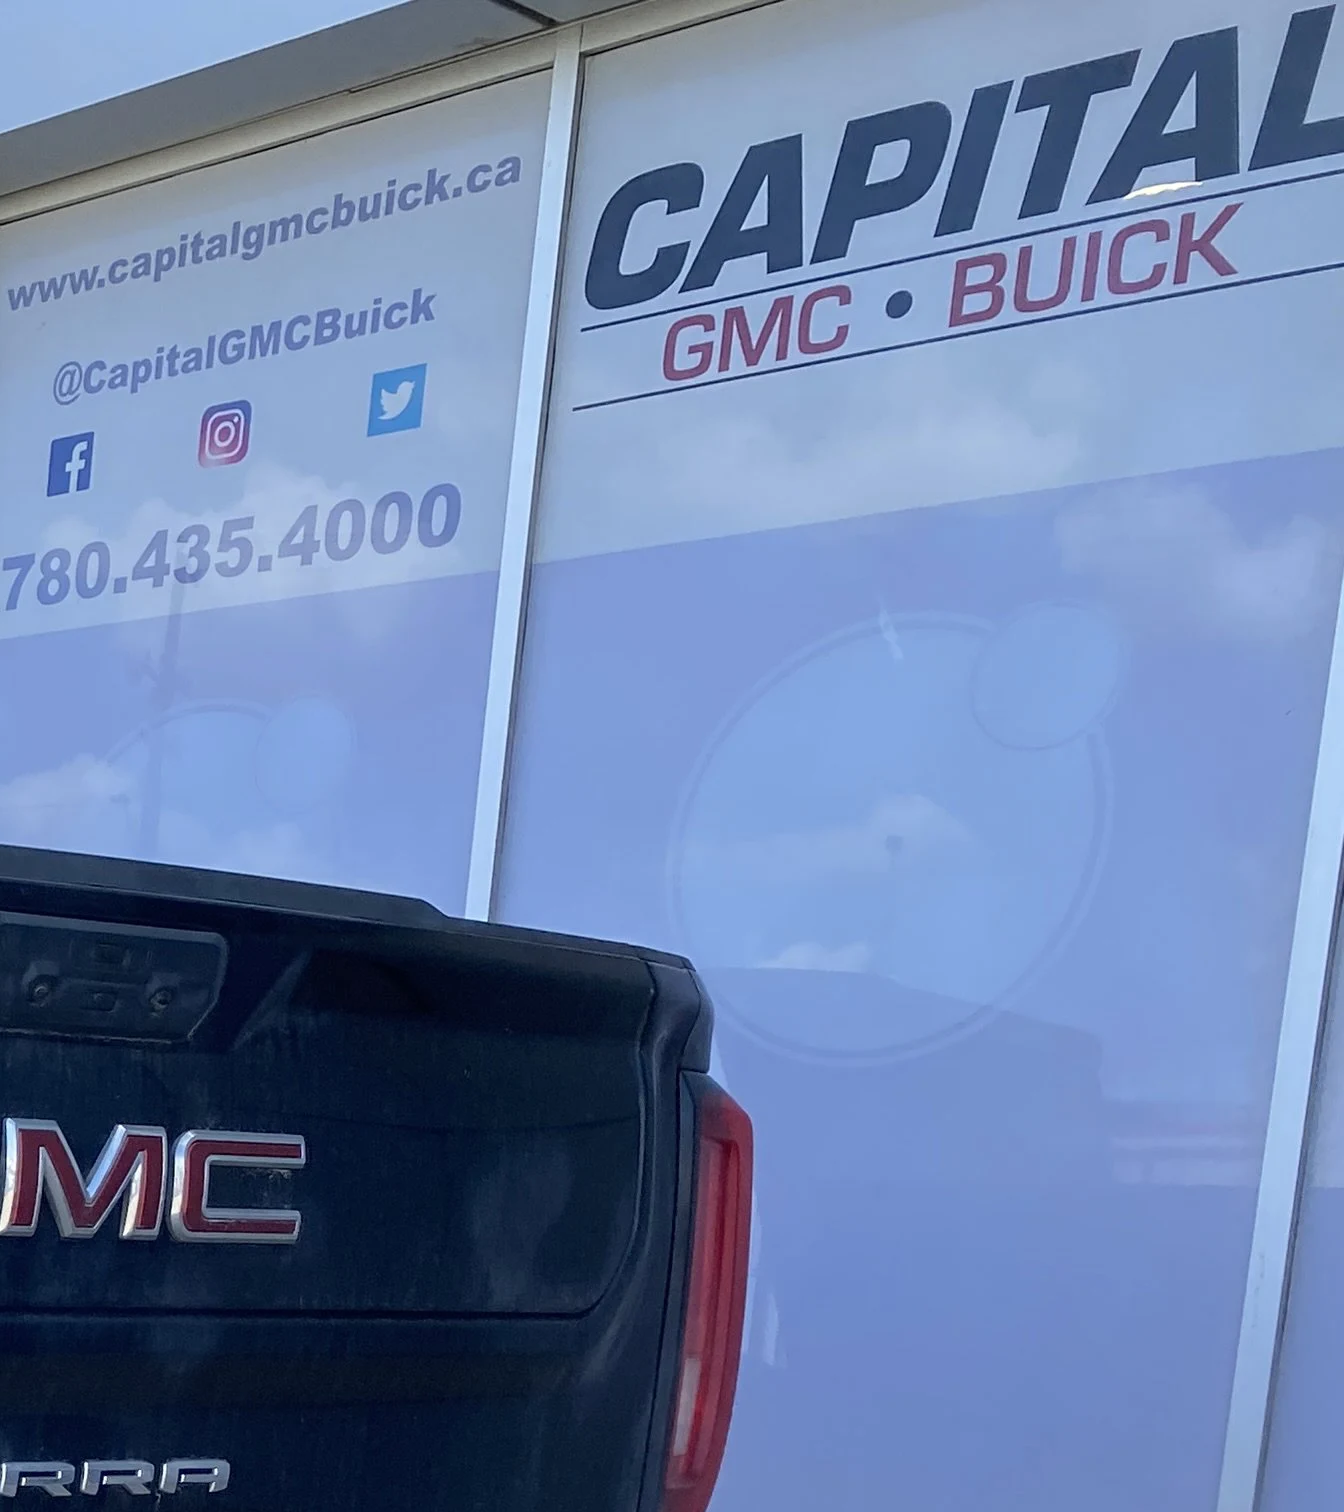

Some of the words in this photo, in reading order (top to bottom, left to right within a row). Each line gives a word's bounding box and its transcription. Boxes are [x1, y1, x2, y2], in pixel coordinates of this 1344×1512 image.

[7, 156, 522, 311] www.capitalgmcbuick.ca
[584, 3, 1344, 310] CAPITAL
[53, 287, 437, 406] @CapitalGMCBuick
[662, 285, 852, 382] GMC
[948, 202, 1244, 328] BUICK
[2, 483, 462, 611] 780.435.4000
